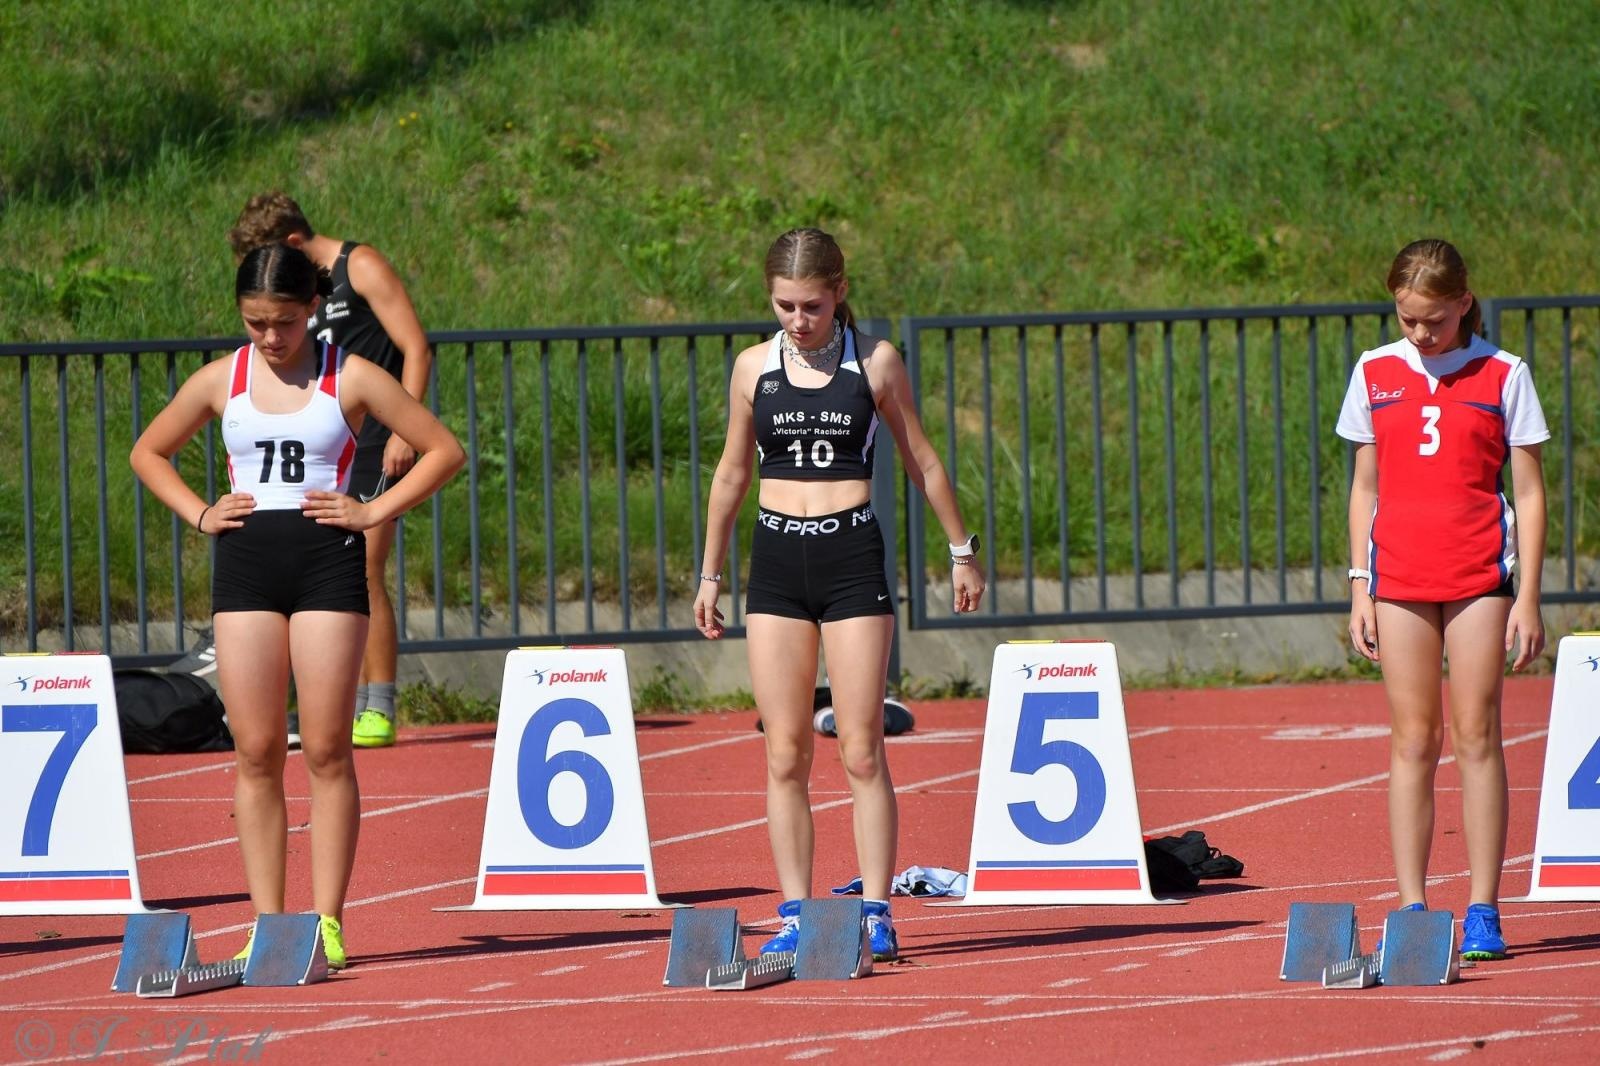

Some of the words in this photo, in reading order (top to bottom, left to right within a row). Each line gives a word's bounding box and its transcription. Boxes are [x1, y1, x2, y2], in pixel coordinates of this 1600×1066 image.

[772, 411, 805, 426] MKS
[820, 411, 852, 426] SMS
[814, 428, 851, 436] Racibórz
[1419, 405, 1442, 456] 3
[254, 440, 305, 483] 78
[787, 439, 835, 468] 10
[783, 518, 840, 536] PRO
[549, 669, 608, 686] polanik
[1038, 663, 1098, 680] polanik
[33, 676, 92, 693] polanik
[517, 697, 615, 850] 6
[1007, 691, 1107, 845] 5
[2, 704, 98, 856] 7
